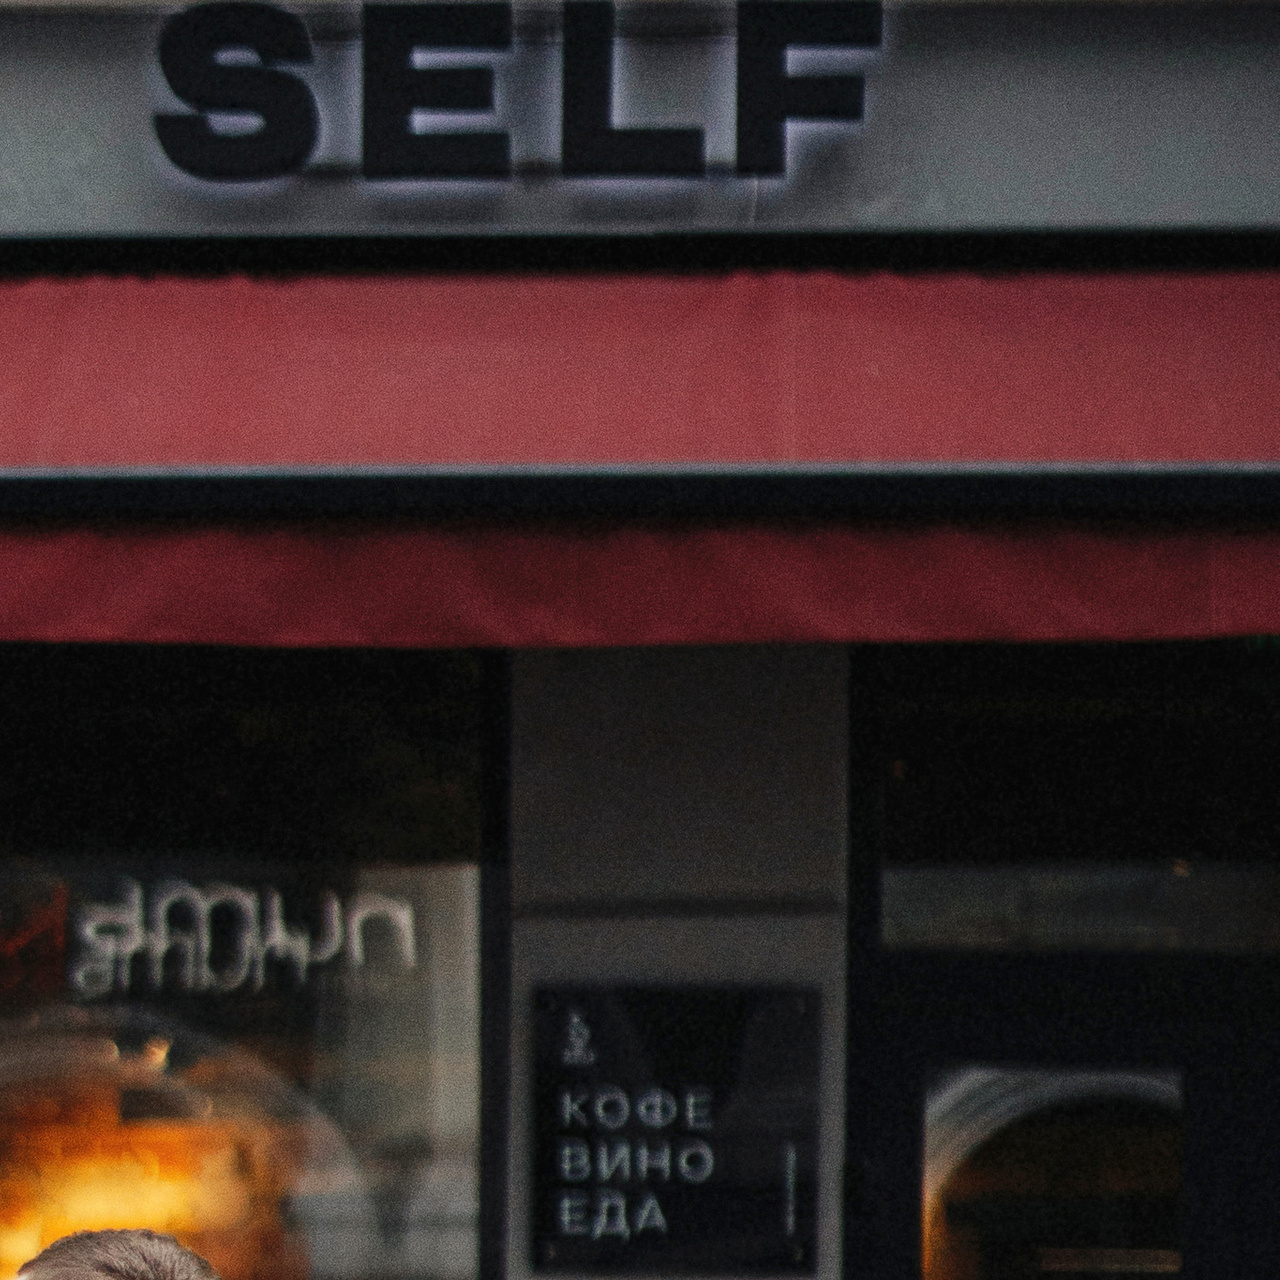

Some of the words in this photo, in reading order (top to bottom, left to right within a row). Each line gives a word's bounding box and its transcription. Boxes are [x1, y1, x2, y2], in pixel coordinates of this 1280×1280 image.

[153, 0, 884, 182] SELF
[560, 1087, 714, 1130] КОФЕ
[560, 1141, 715, 1183] ВИНО
[560, 1191, 668, 1241] ЕДА
